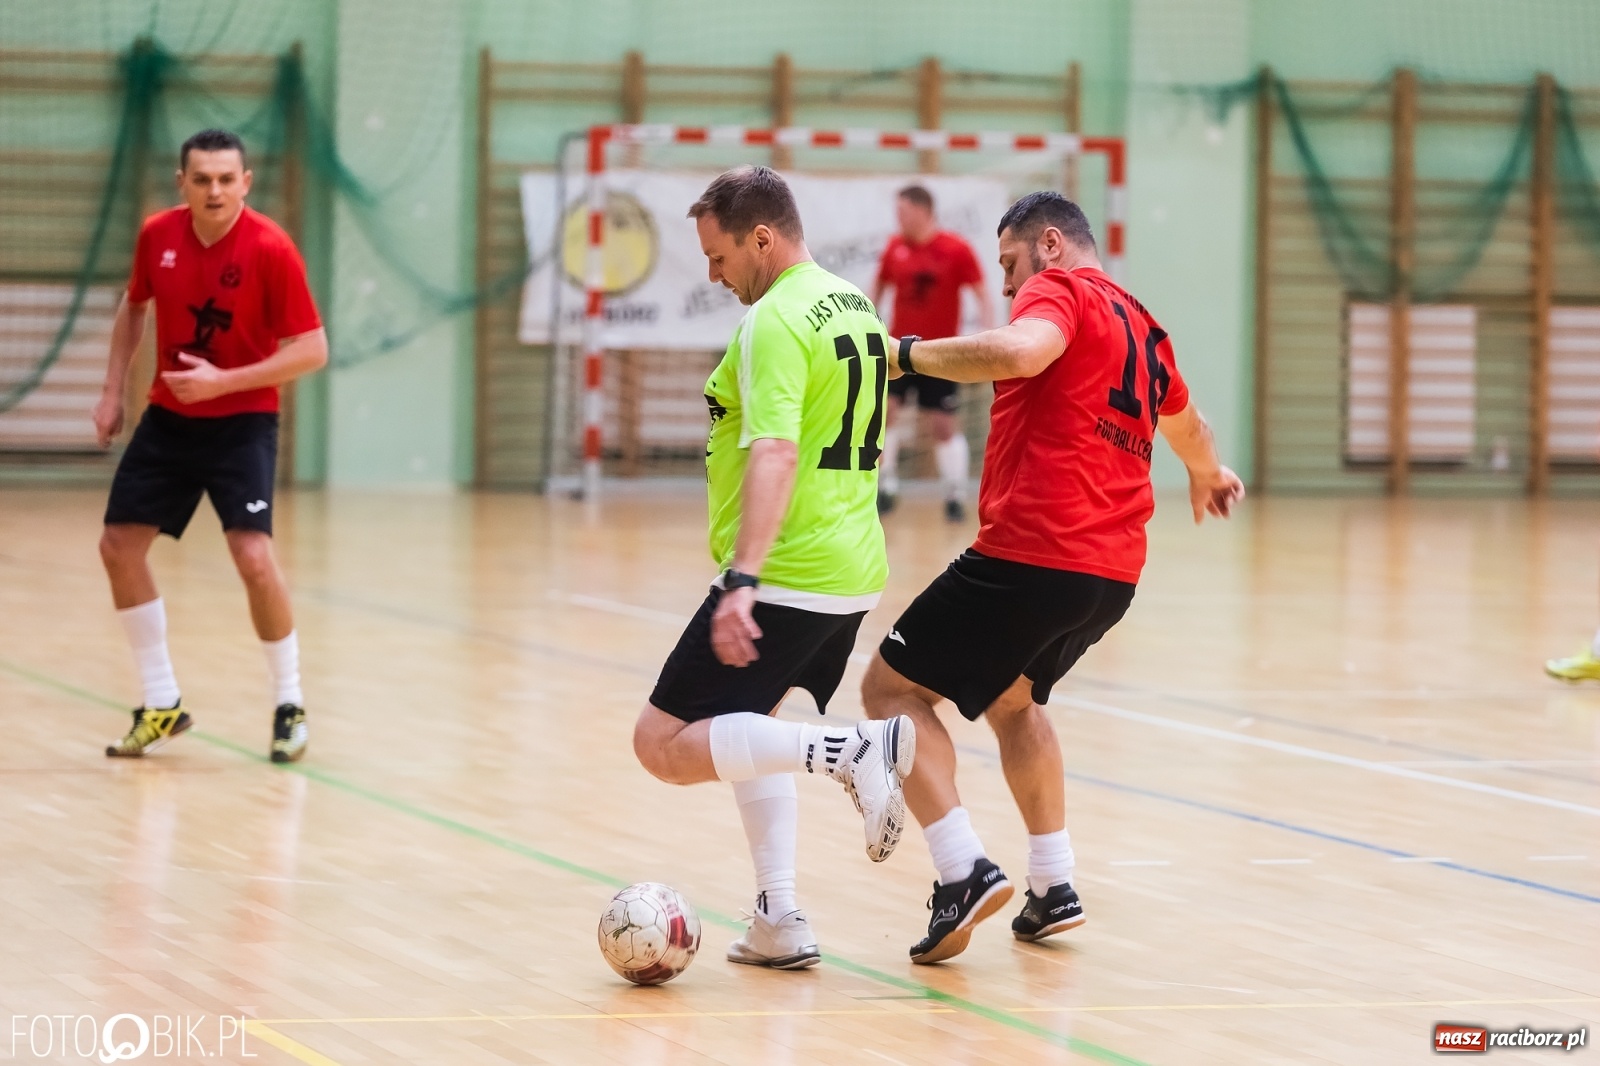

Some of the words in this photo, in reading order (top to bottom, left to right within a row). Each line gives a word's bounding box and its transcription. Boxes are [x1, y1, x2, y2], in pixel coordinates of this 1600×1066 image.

[805, 299, 833, 333] LKS
[816, 332, 887, 471] 11
[1108, 300, 1171, 433] 16
[852, 738, 872, 765] PUMA
